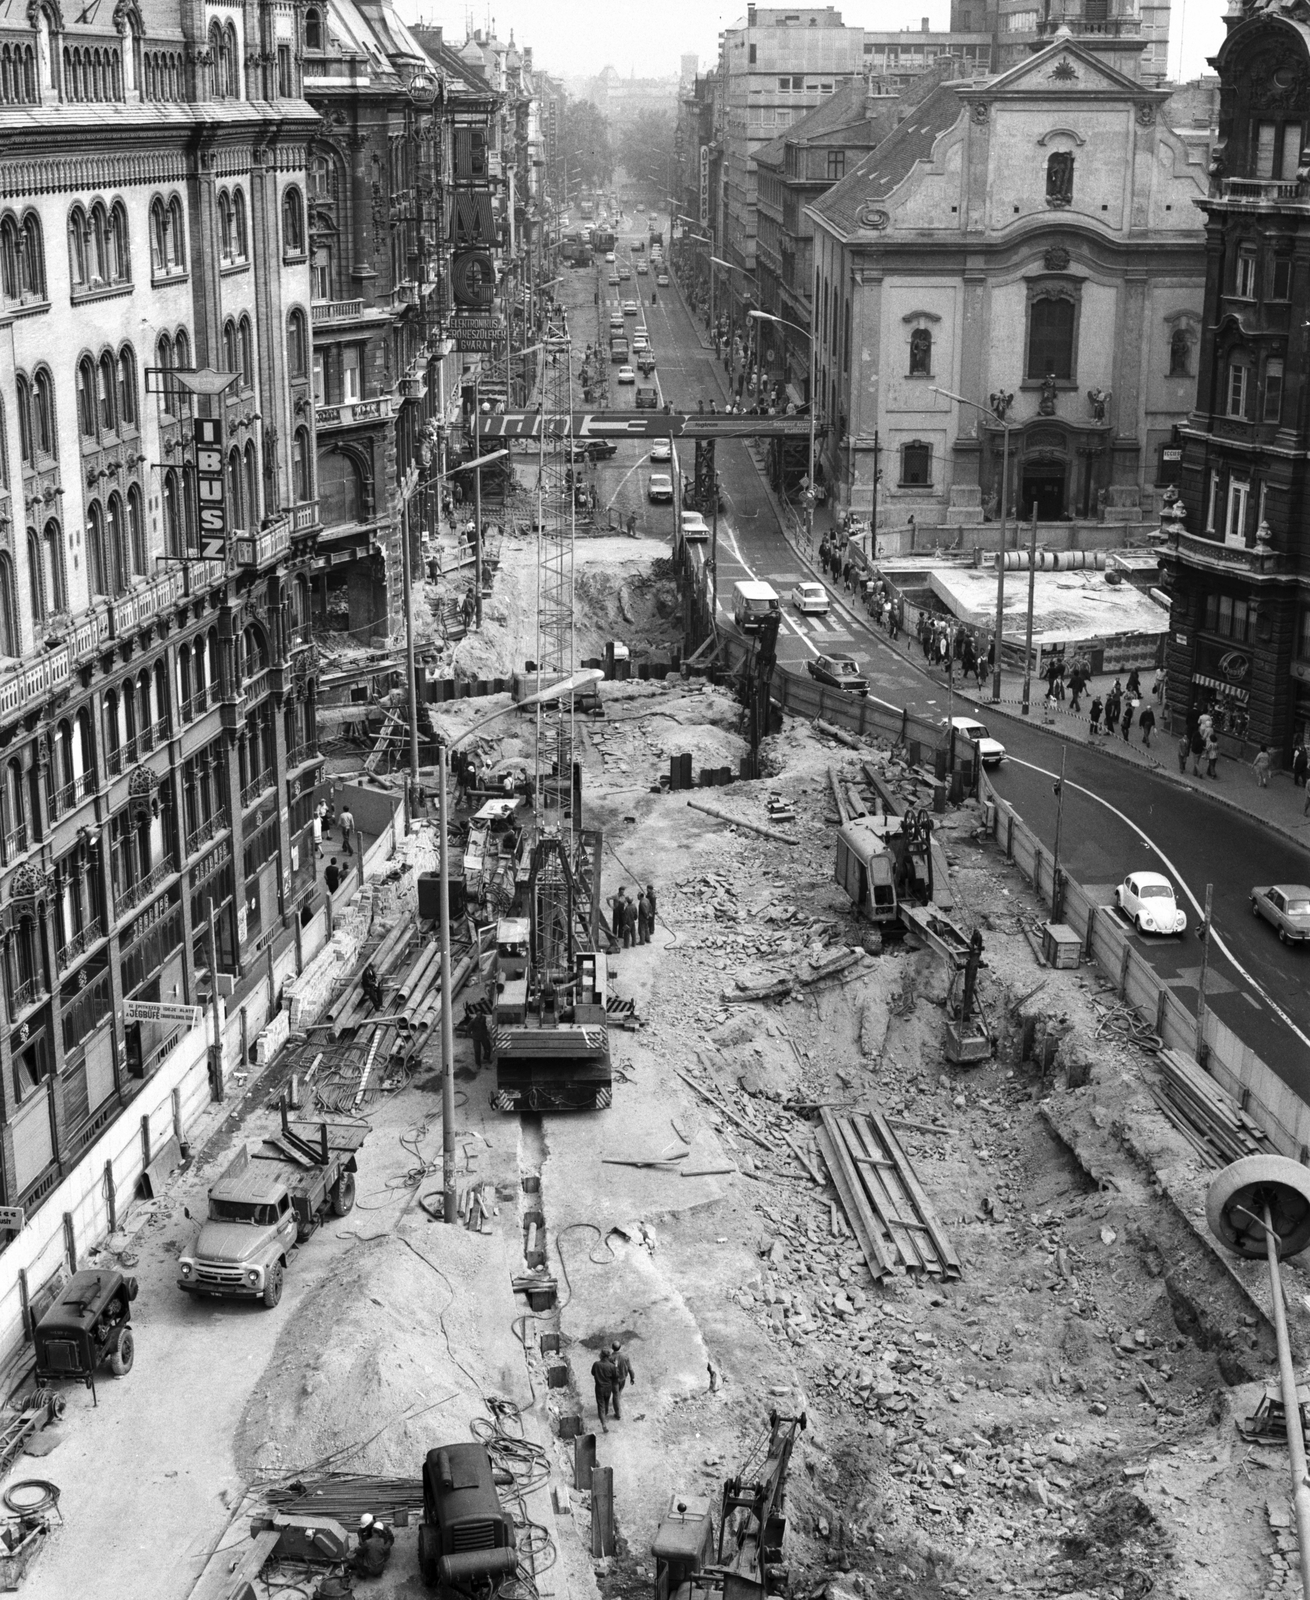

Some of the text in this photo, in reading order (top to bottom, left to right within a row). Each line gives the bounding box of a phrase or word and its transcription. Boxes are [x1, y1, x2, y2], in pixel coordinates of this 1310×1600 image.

[445, 127, 502, 305] EMG
[450, 318, 498, 329] ELEKTRONIKUS
[197, 421, 225, 558] IBUSZ
